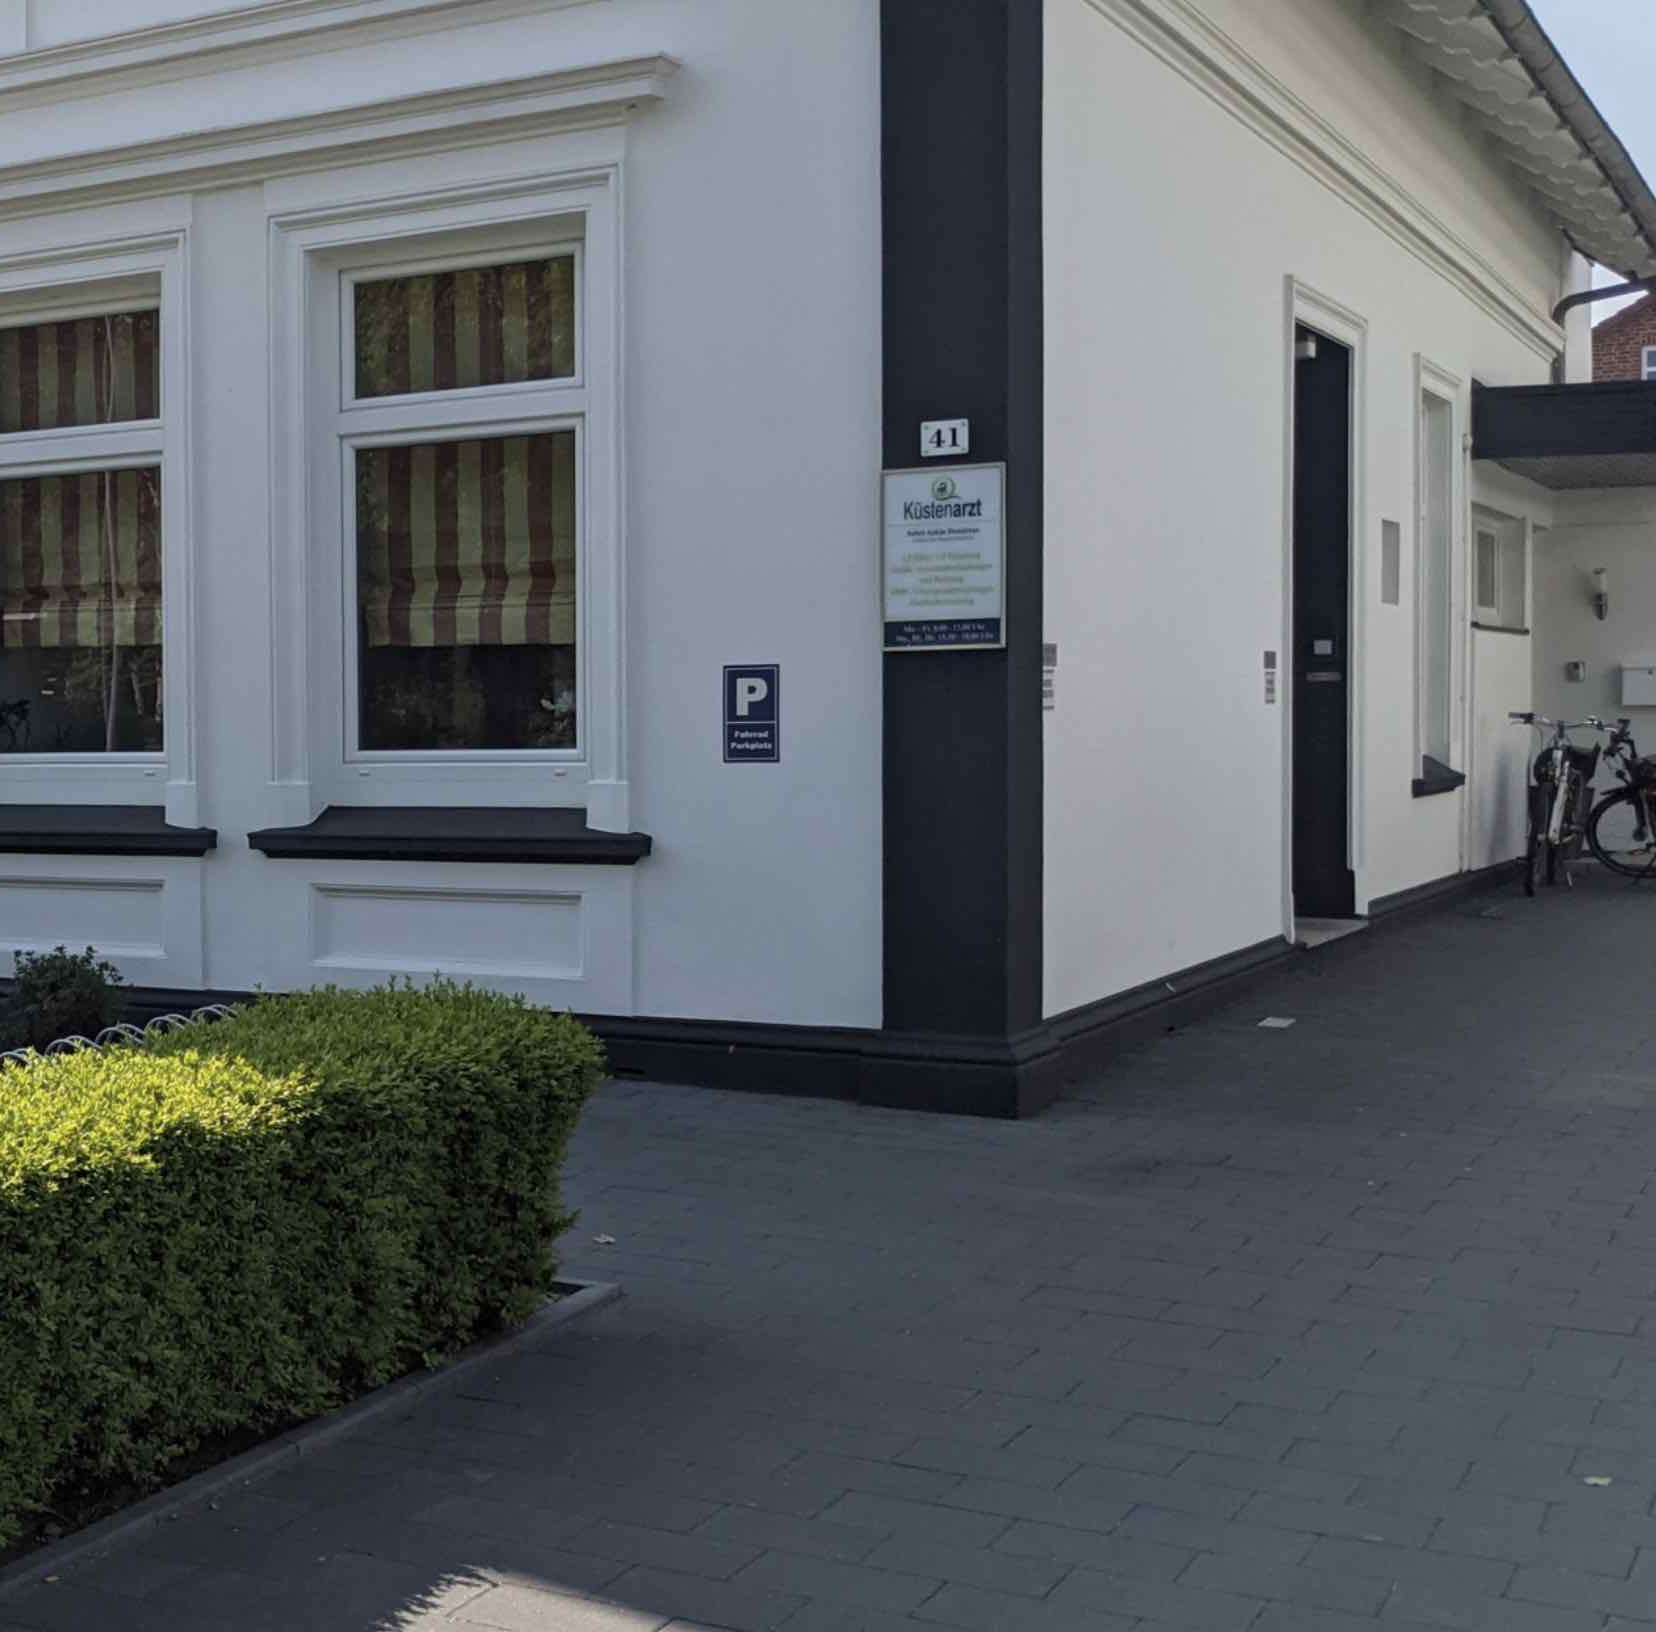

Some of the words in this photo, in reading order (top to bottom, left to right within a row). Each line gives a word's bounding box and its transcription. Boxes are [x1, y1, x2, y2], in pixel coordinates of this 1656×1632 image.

[928, 427, 960, 448] 41
[903, 499, 982, 520] Küstenarzt
[736, 678, 768, 716] P
